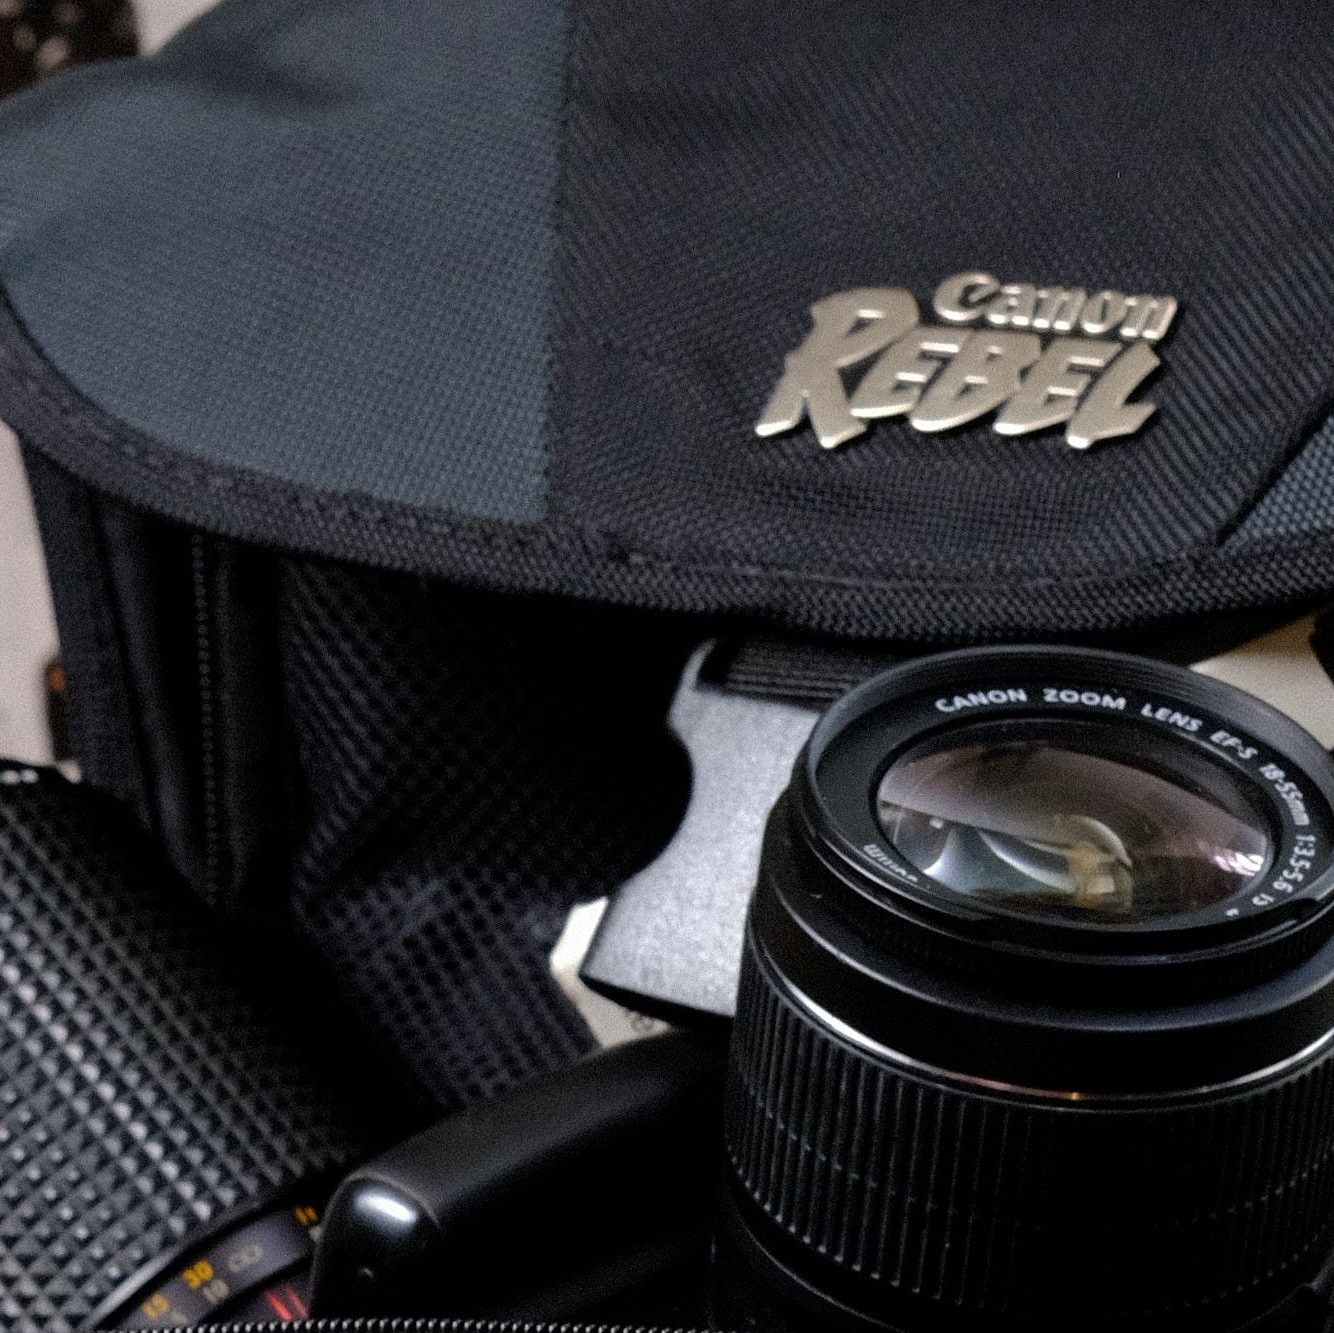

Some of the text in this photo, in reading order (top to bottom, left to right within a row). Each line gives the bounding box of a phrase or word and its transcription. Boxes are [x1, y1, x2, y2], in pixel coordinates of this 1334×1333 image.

[933, 271, 1178, 340] Canon
[754, 286, 1161, 450] REBEL
[934, 688, 1028, 713] CANON
[1042, 687, 1127, 711] ZOOM
[1140, 703, 1204, 732] LENS
[1209, 729, 1259, 760] EF-S
